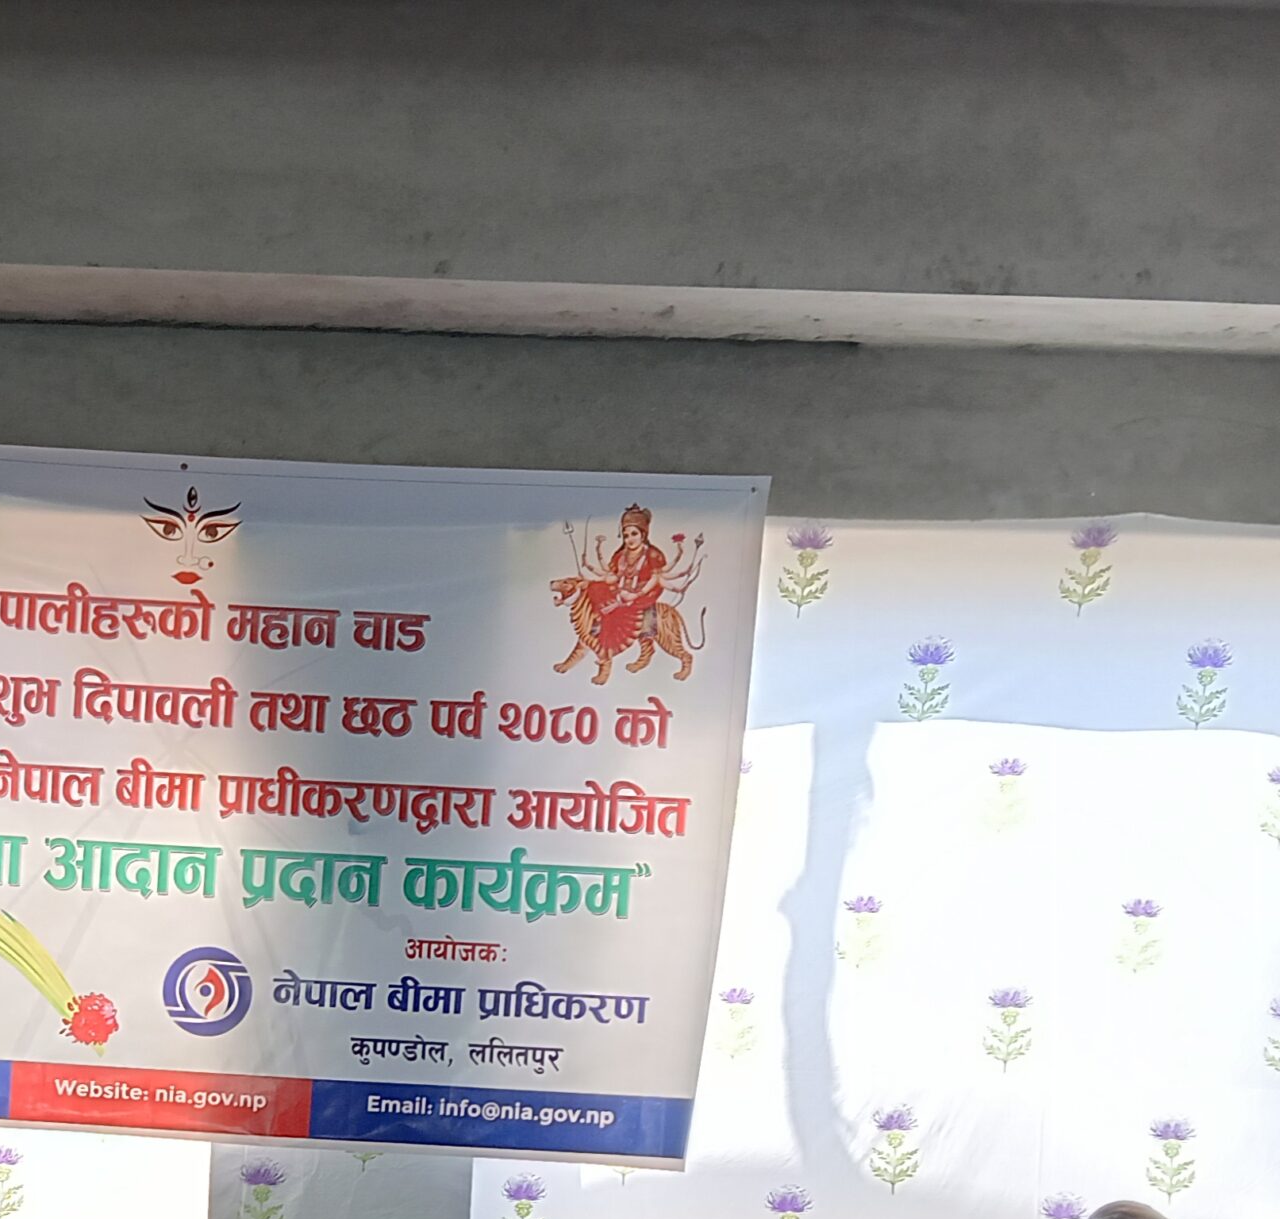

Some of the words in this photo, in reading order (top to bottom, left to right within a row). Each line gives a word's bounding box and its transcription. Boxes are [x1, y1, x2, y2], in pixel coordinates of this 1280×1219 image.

[227, 603, 340, 650] महान
[353, 610, 431, 652] चाड
[73, 667, 239, 729] दिपावली
[250, 691, 331, 734] तथा
[342, 697, 417, 738] छठ
[430, 691, 487, 740] पर्व
[498, 702, 599, 745] २०८०
[614, 696, 674, 749] को
[116, 758, 205, 812] बीमा
[218, 766, 497, 836] प्राधीकरणद्वारा
[507, 780, 691, 838] आयोजित
[43, 836, 223, 899] आदान
[241, 848, 388, 908] प्रदान
[272, 969, 376, 1011] नेपाल
[387, 976, 466, 1015] बीमा
[477, 981, 650, 1025] प्राधिकरण
[468, 1037, 565, 1074] ललितपुर
[54, 1078, 149, 1101] Website:
[154, 1085, 267, 1112] nia.gov.np
[366, 1095, 433, 1116] Email:
[439, 1098, 616, 1129] info@nia.gov.np
